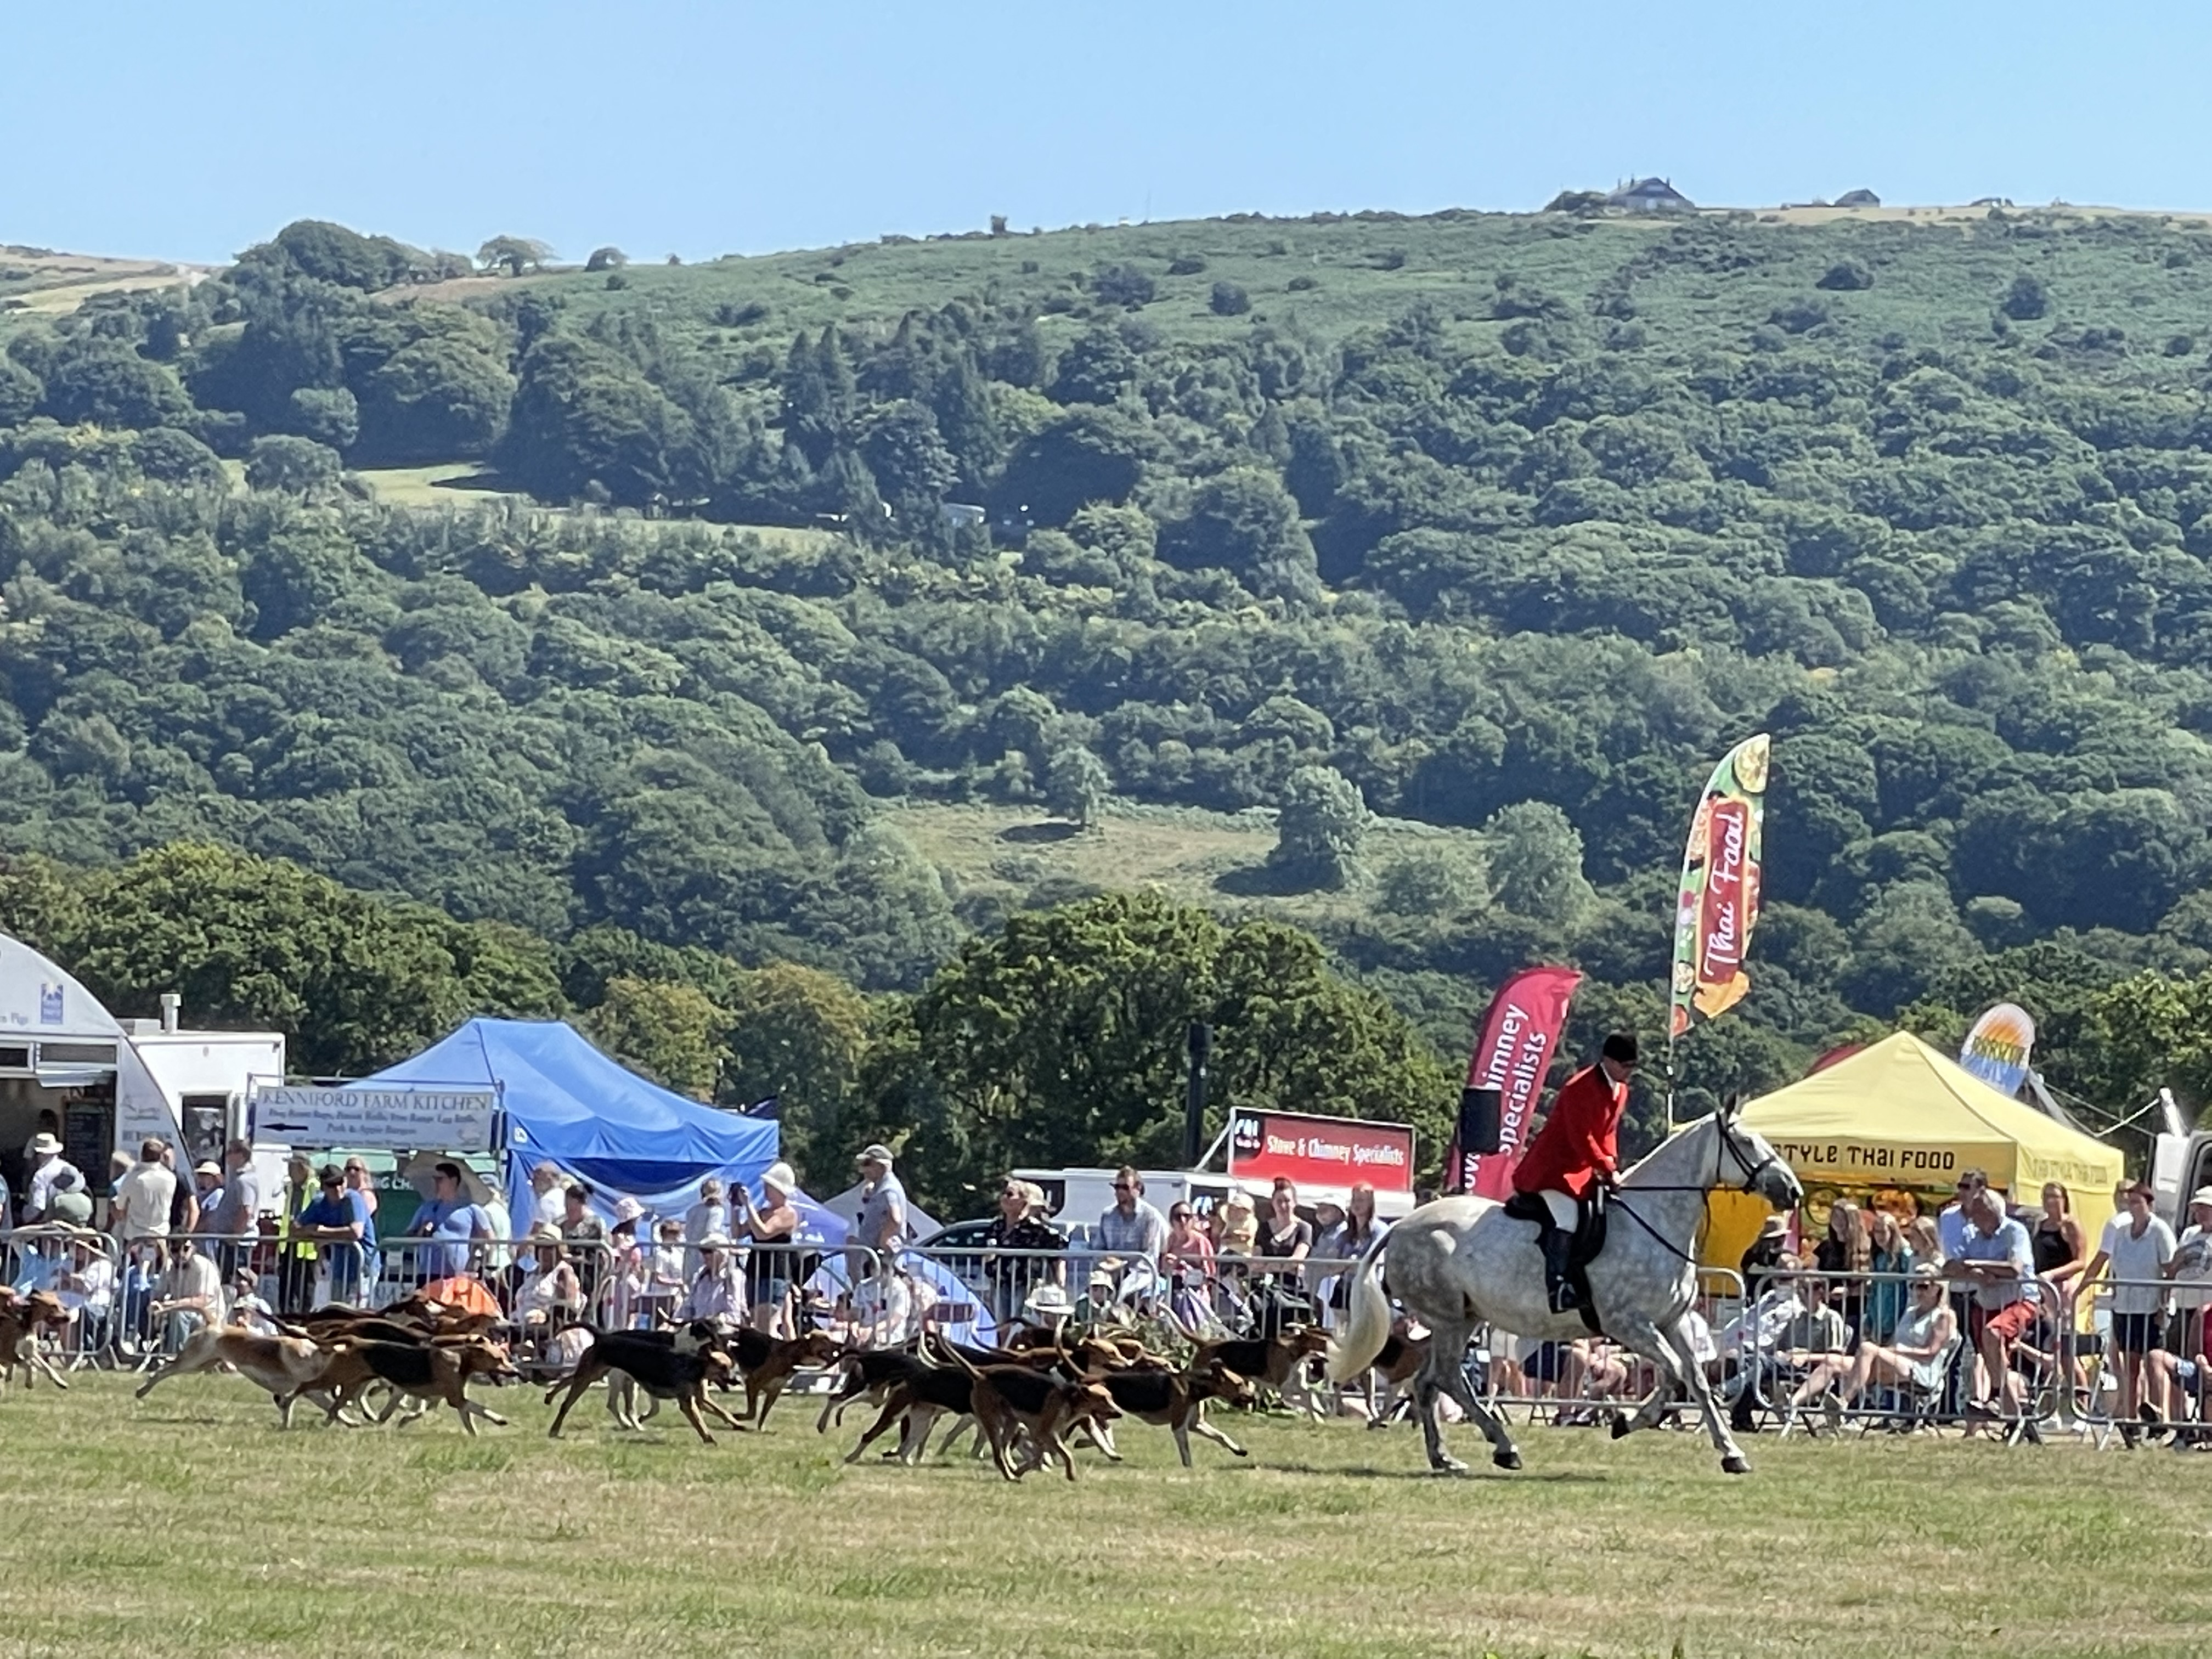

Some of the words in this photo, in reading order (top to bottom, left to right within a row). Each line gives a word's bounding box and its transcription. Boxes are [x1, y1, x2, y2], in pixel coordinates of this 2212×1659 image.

[1709, 811, 1743, 895] Food
[1703, 901, 1739, 977] Thai
[263, 1091, 358, 1107] KENNIFORD
[364, 1094, 407, 1109] FARM
[413, 1094, 486, 1110] KITCHEN
[1267, 1135, 1296, 1155] Stove
[1298, 1138, 1306, 1157] &
[1308, 1138, 1351, 1165] Chimney
[1353, 1144, 1404, 1166] Specialists
[1900, 1150, 1955, 1170] FOOD
